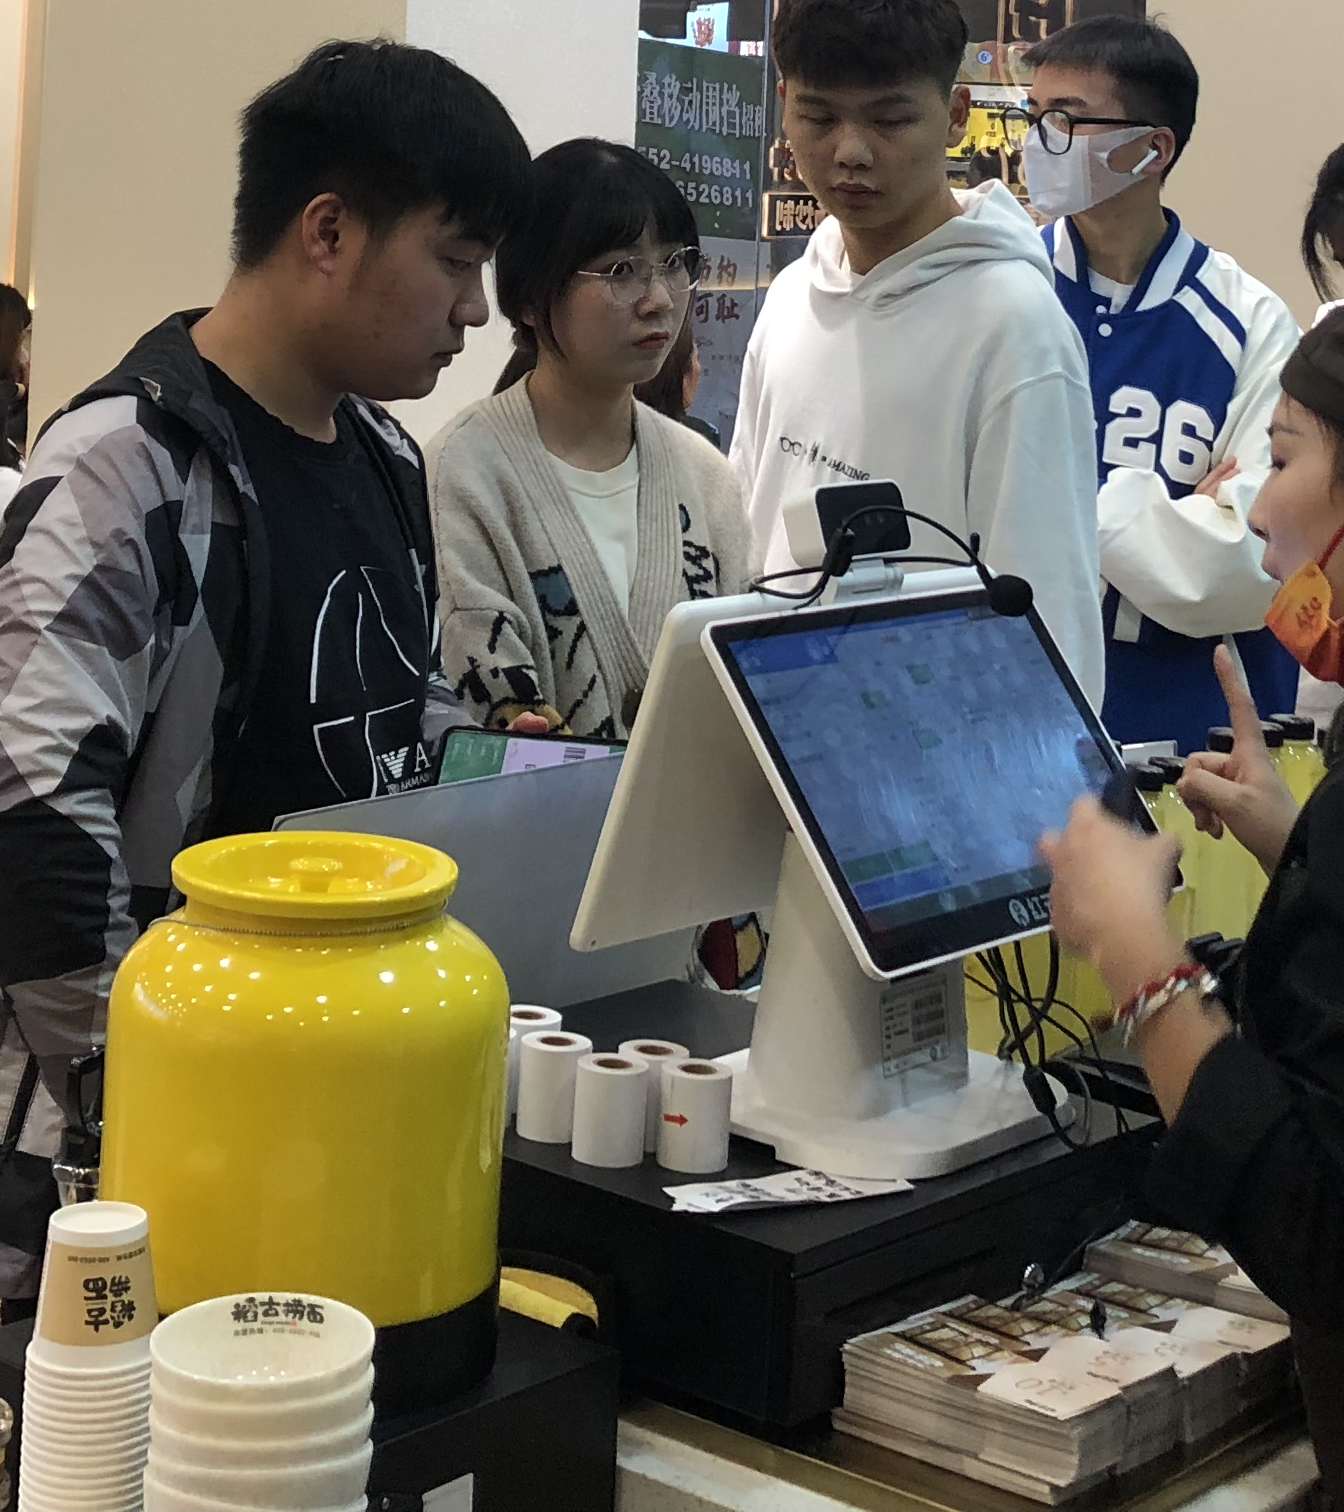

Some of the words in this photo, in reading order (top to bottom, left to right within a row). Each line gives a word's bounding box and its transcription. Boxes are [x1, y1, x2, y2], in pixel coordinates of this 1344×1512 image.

[1102, 385, 1215, 486] 26
[230, 1295, 325, 1325] 稻古捞面
